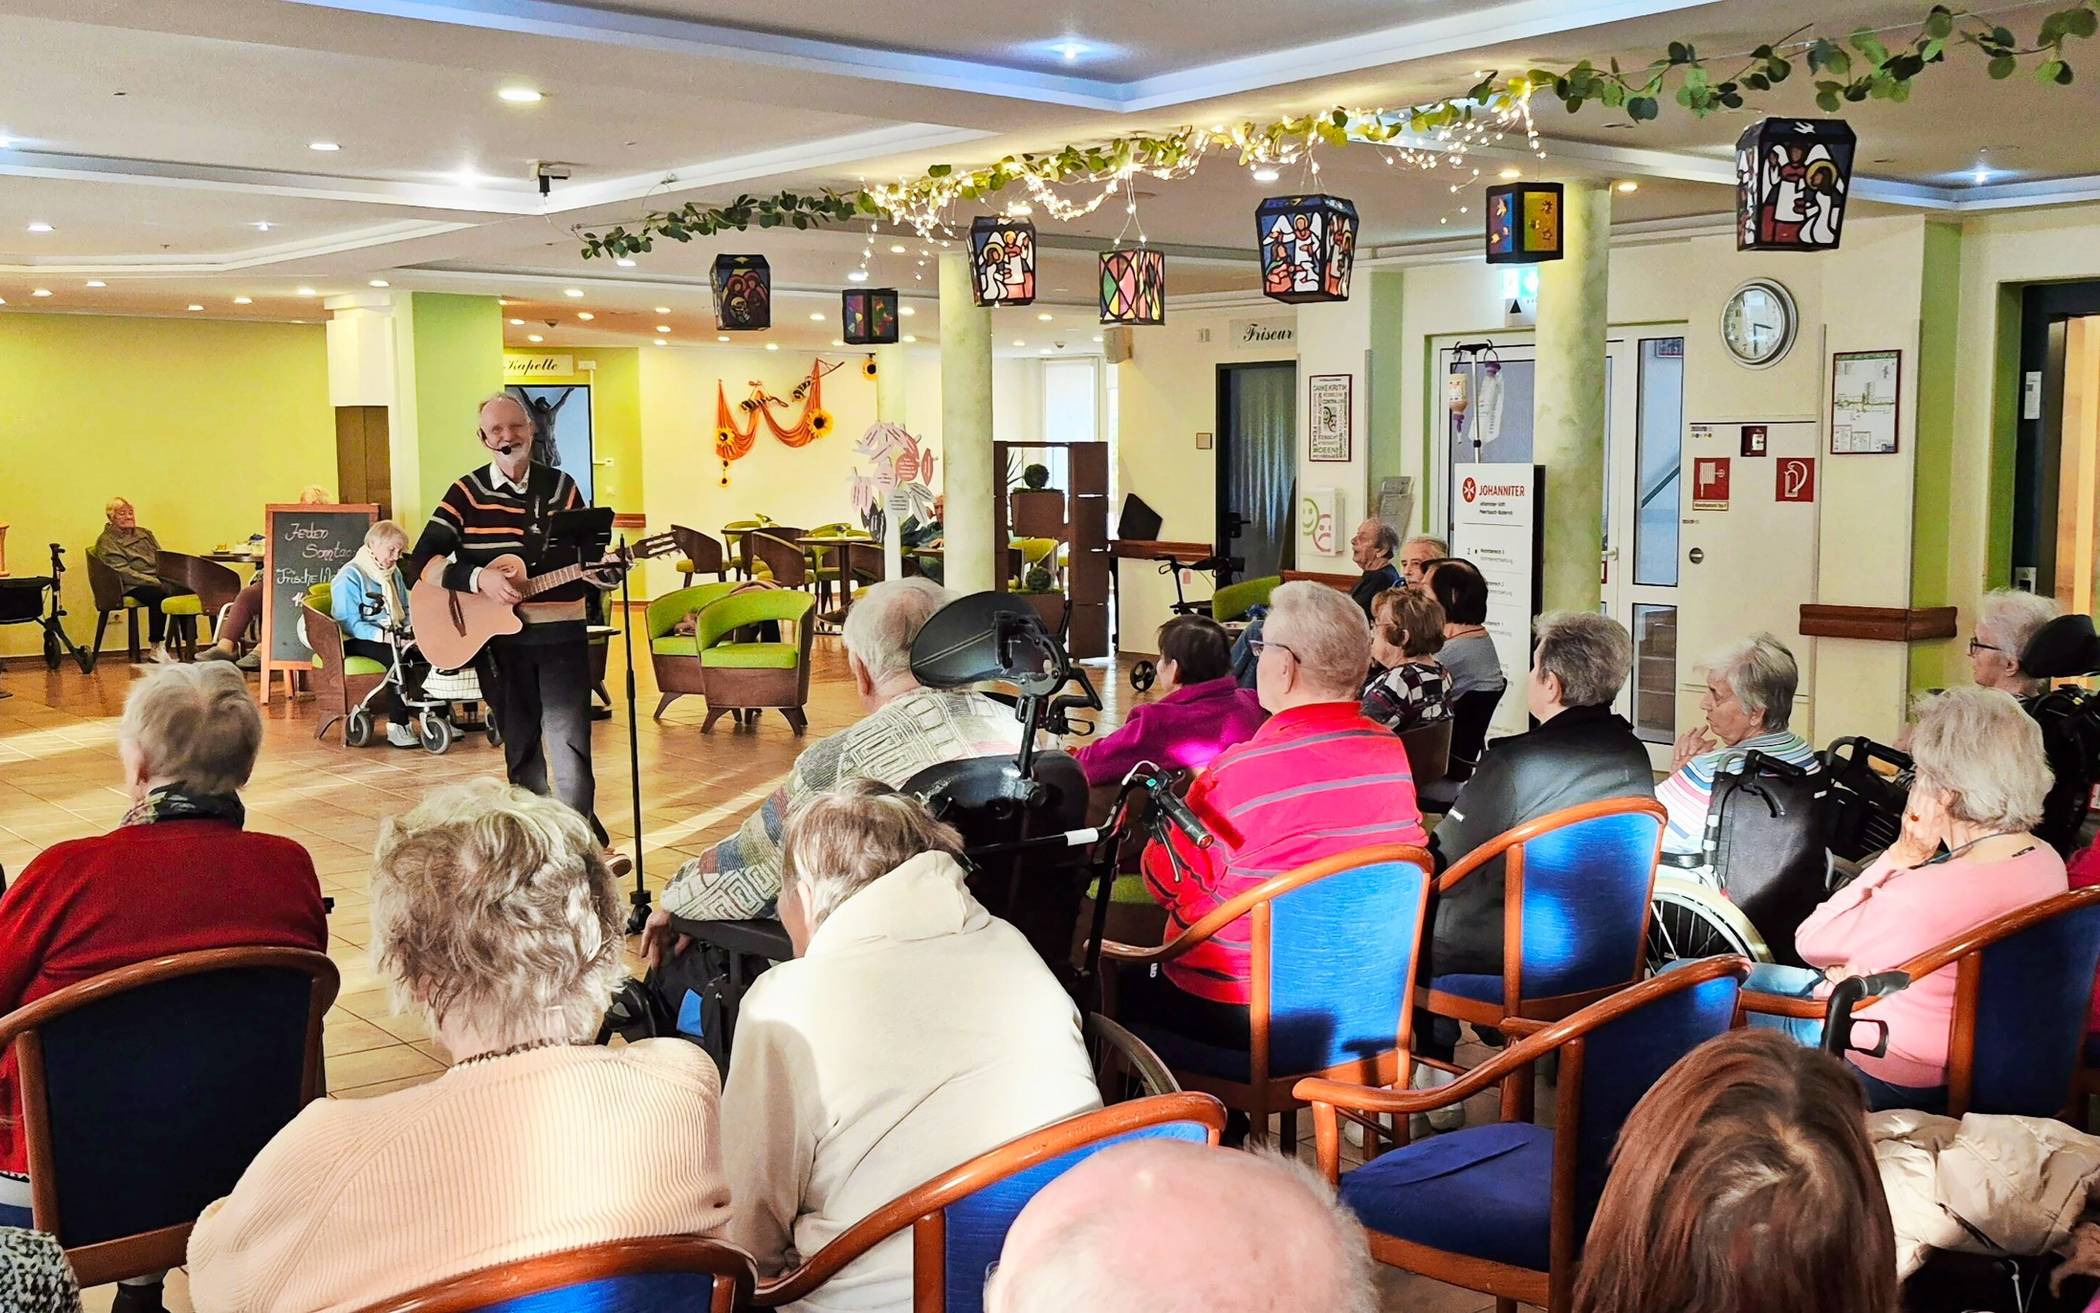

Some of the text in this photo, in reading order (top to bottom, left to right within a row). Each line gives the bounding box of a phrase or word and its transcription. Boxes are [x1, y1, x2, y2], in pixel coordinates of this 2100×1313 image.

[1243, 323, 1294, 342] Friseur
[506, 358, 558, 375] Kapelle
[1479, 485, 1525, 497] JOHANNITER
[285, 522, 329, 541] Jeden
[276, 567, 319, 586] Frische
